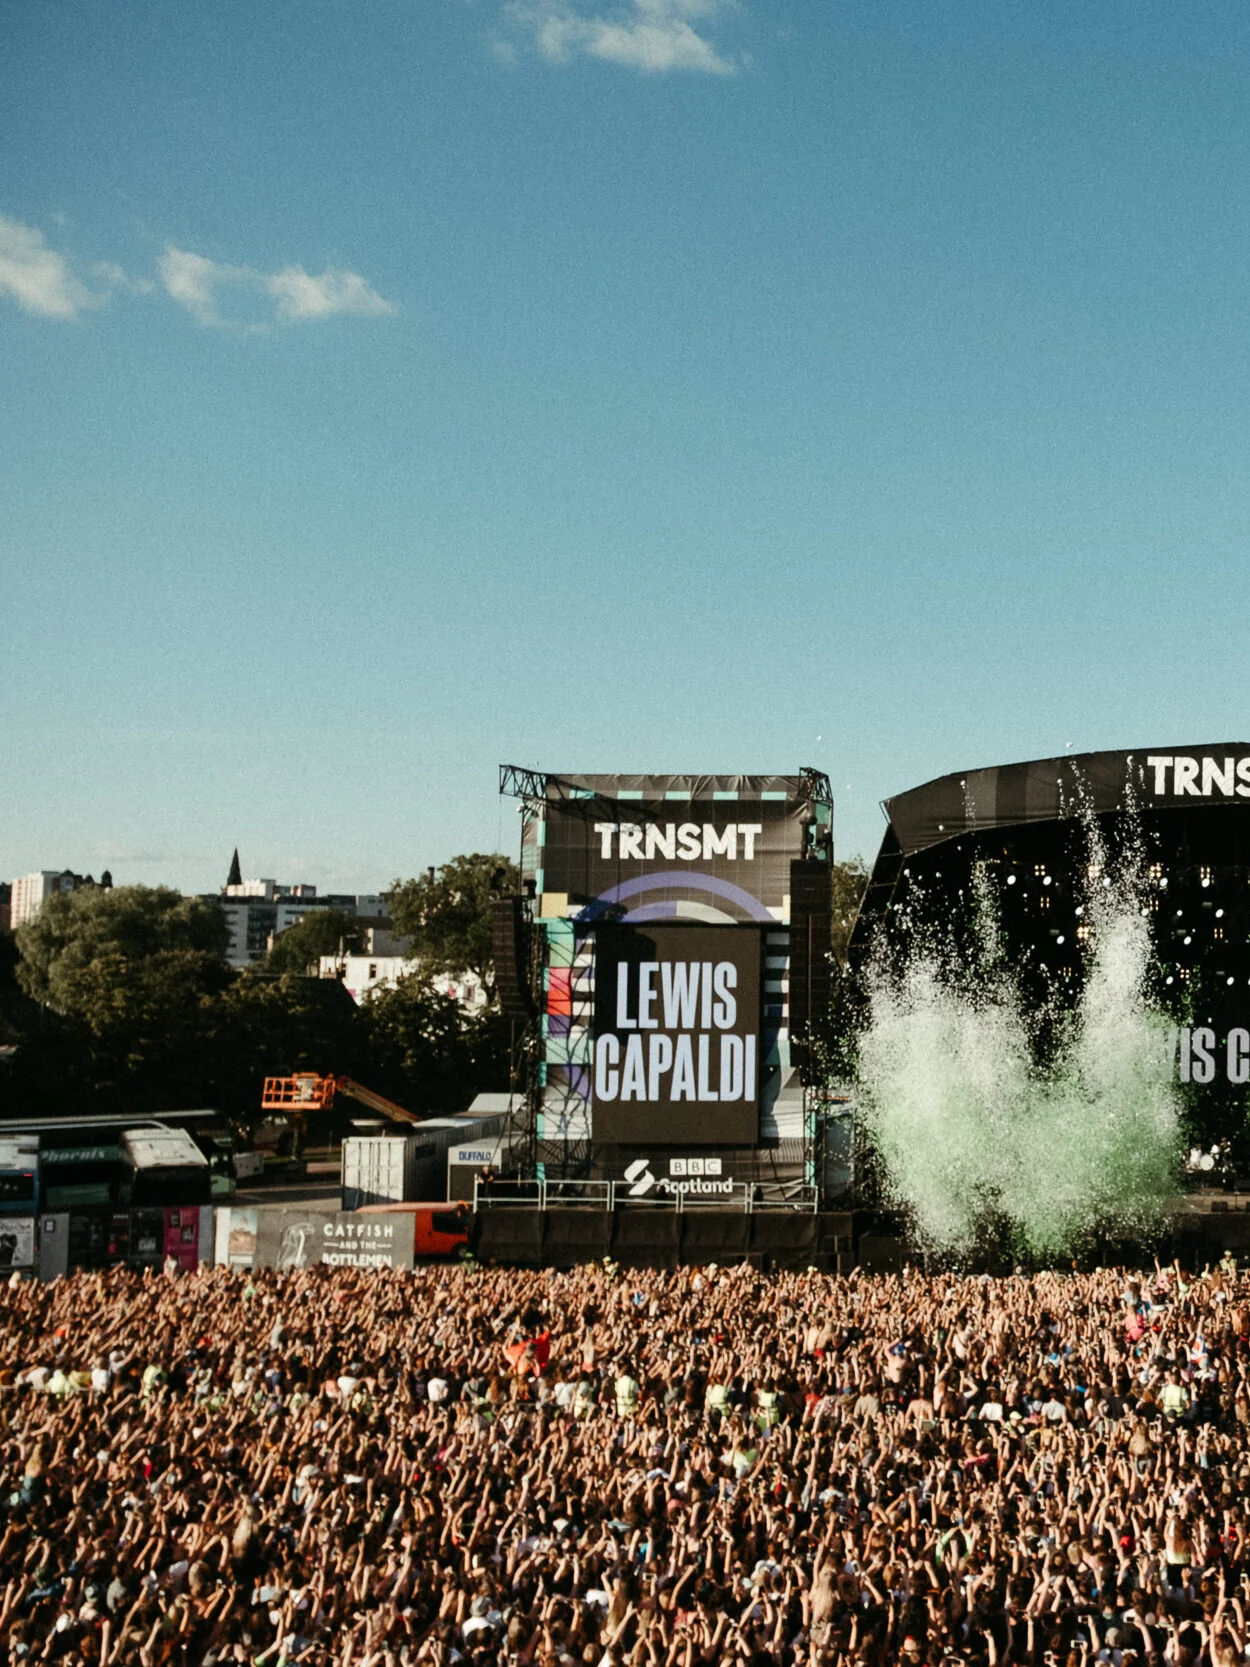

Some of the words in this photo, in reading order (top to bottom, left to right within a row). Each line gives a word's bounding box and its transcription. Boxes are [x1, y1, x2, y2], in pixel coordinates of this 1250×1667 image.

[594, 822, 762, 860] TRNSMT
[616, 961, 737, 1029] LEWIS
[595, 1033, 756, 1101] CAPALDI
[671, 1159, 721, 1175] BBC
[323, 1223, 393, 1238] CATFISH
[339, 1241, 358, 1250] AND
[360, 1241, 377, 1250] THE
[322, 1252, 392, 1267] BOTTLEMEN
